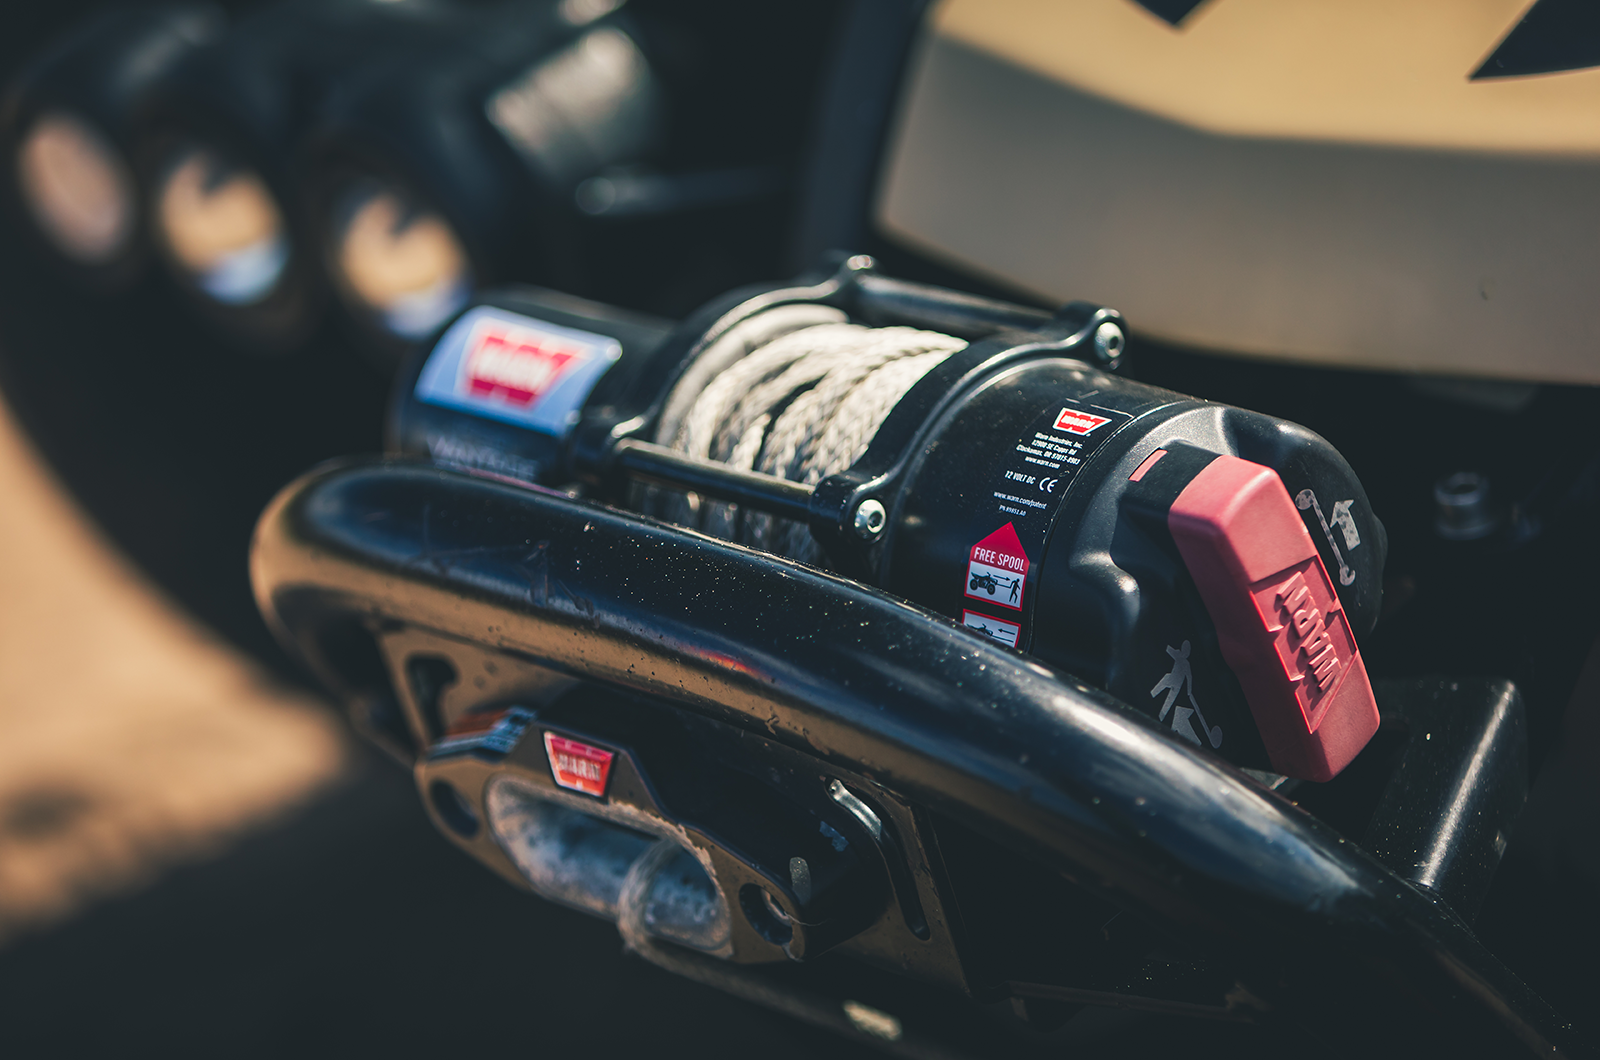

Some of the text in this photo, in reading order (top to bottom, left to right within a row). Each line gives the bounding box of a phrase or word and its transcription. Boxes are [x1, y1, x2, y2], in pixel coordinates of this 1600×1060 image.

[1060, 415, 1096, 429] WARN
[1068, 448, 1078, 456] Rd
[1024, 456, 1061, 470] www.warn.com
[1004, 470, 1037, 485] 12 VOLT DC
[993, 491, 1047, 510] www.warn.com/patent
[973, 546, 1024, 572] FREE SPOOL
[1275, 571, 1342, 692] WARN
